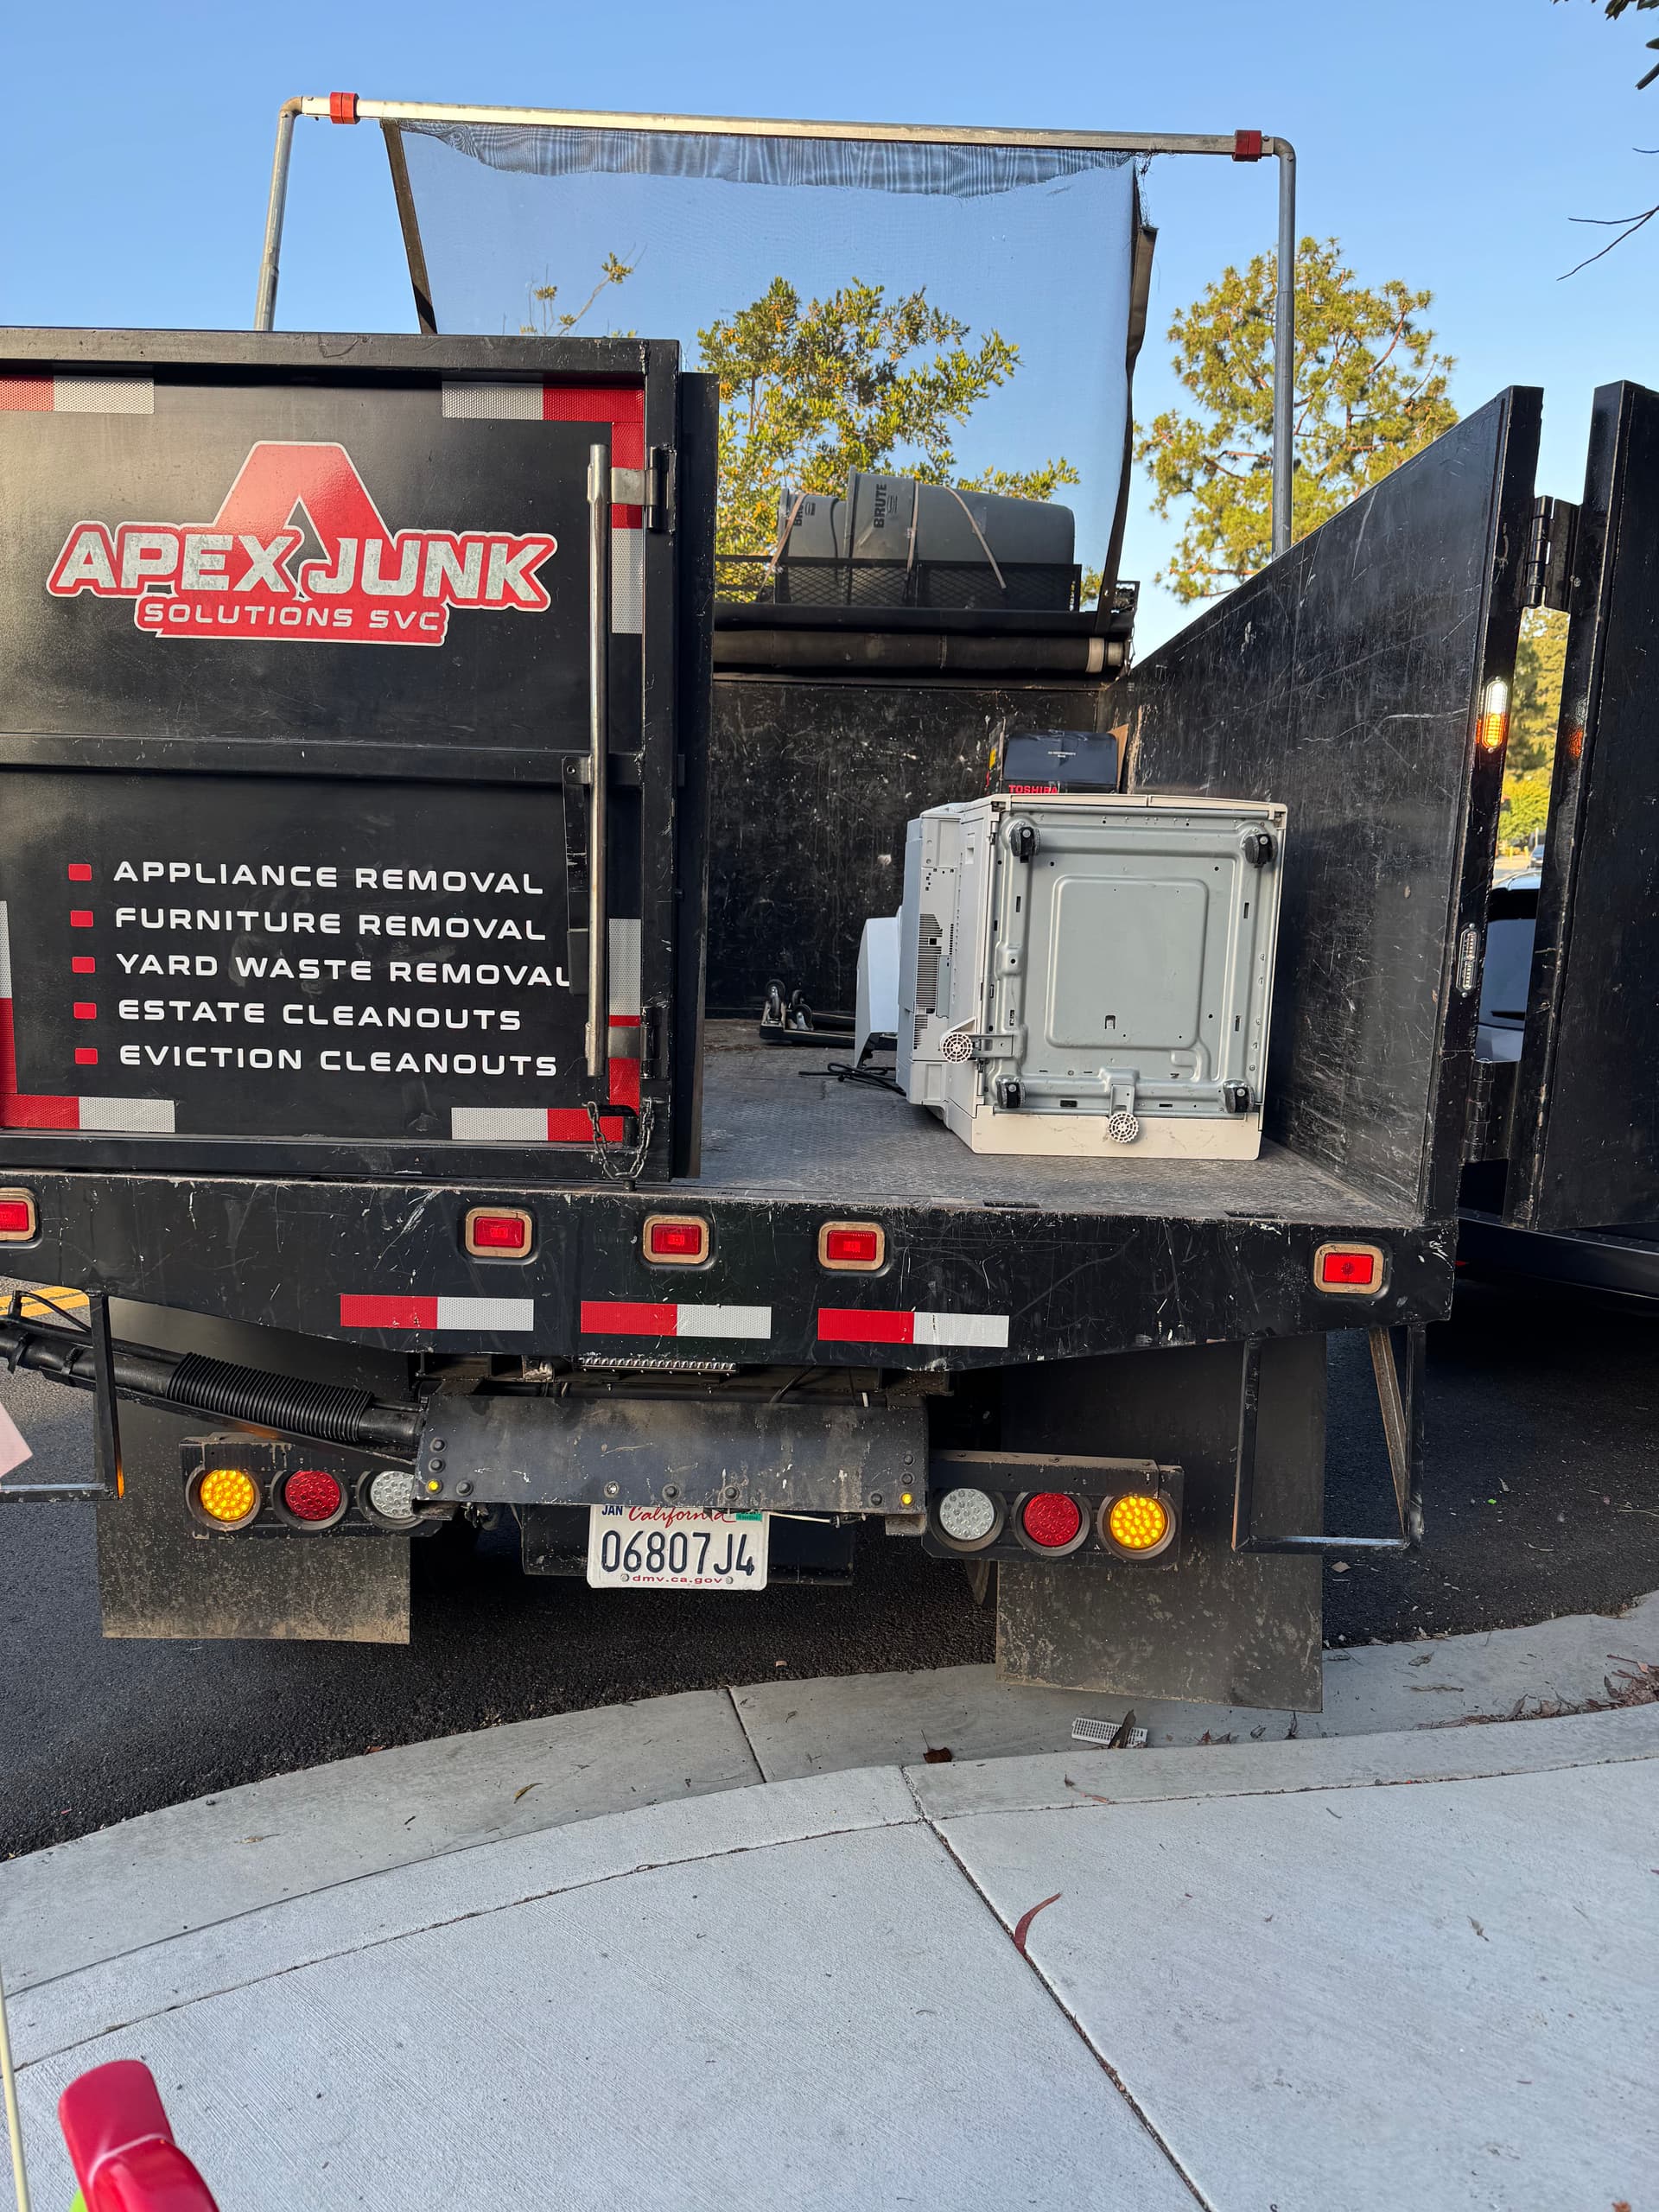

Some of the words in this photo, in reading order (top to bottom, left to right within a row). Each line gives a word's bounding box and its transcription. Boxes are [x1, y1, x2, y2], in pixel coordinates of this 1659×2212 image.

[874, 484, 887, 528] BRUTE
[56, 532, 302, 593] APEX
[307, 538, 550, 601] JUNK
[143, 602, 354, 629] SOLUTIONS
[369, 608, 442, 632] SVC
[1008, 785, 1058, 794] TOSHIBA
[113, 861, 338, 887] APPLIANCE
[355, 868, 544, 894] REMOVAL
[116, 907, 341, 934] FURNITURE
[359, 914, 547, 941] REMOVAL
[116, 953, 218, 976] YARD
[235, 957, 372, 982] WASTE
[390, 961, 571, 987] REMOVAL
[118, 999, 266, 1024] ESTATE
[283, 1004, 521, 1031] CLEANOUTS
[119, 1045, 302, 1070] EVICTION
[320, 1050, 557, 1077] CLEANOUTS
[601, 1505, 622, 1516] JAN
[601, 1530, 755, 1576] 06807J4
[632, 1574, 723, 1585] dmv.ca.gov
